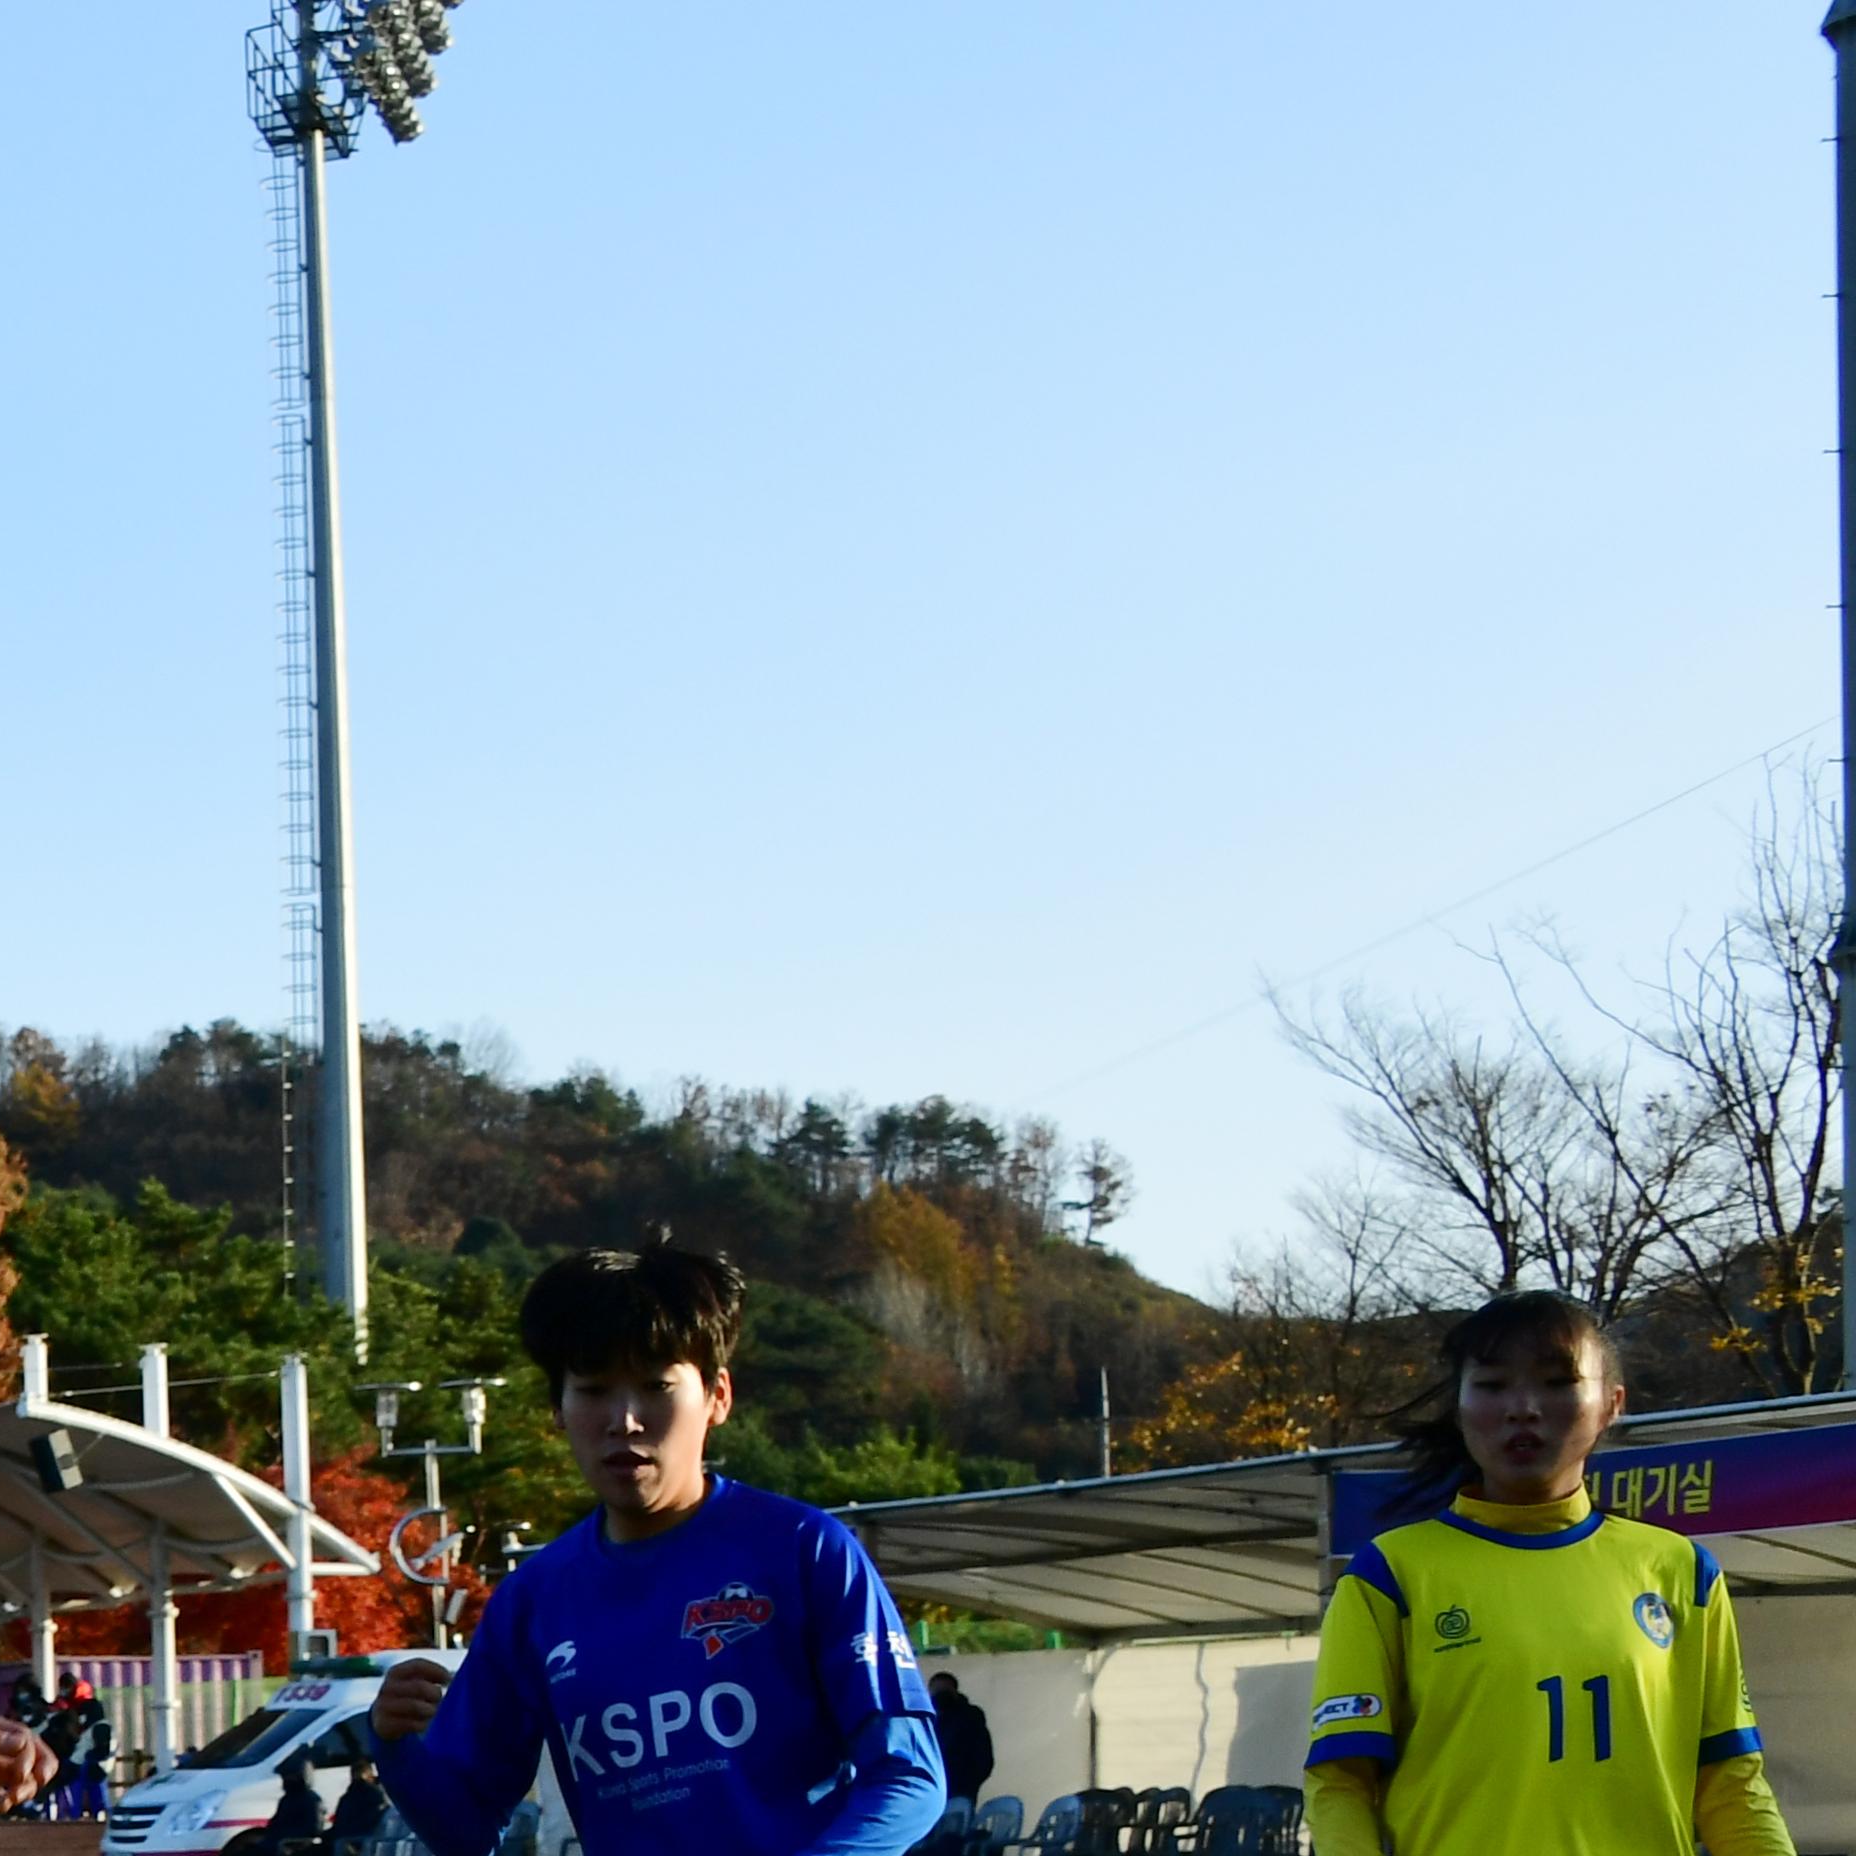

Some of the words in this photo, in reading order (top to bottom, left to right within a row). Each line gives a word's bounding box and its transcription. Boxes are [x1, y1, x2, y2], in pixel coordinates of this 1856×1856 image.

[1611, 1459, 1713, 1518] 대기실
[560, 1681, 757, 1782] KSPO
[1536, 1674, 1612, 1763] 11
